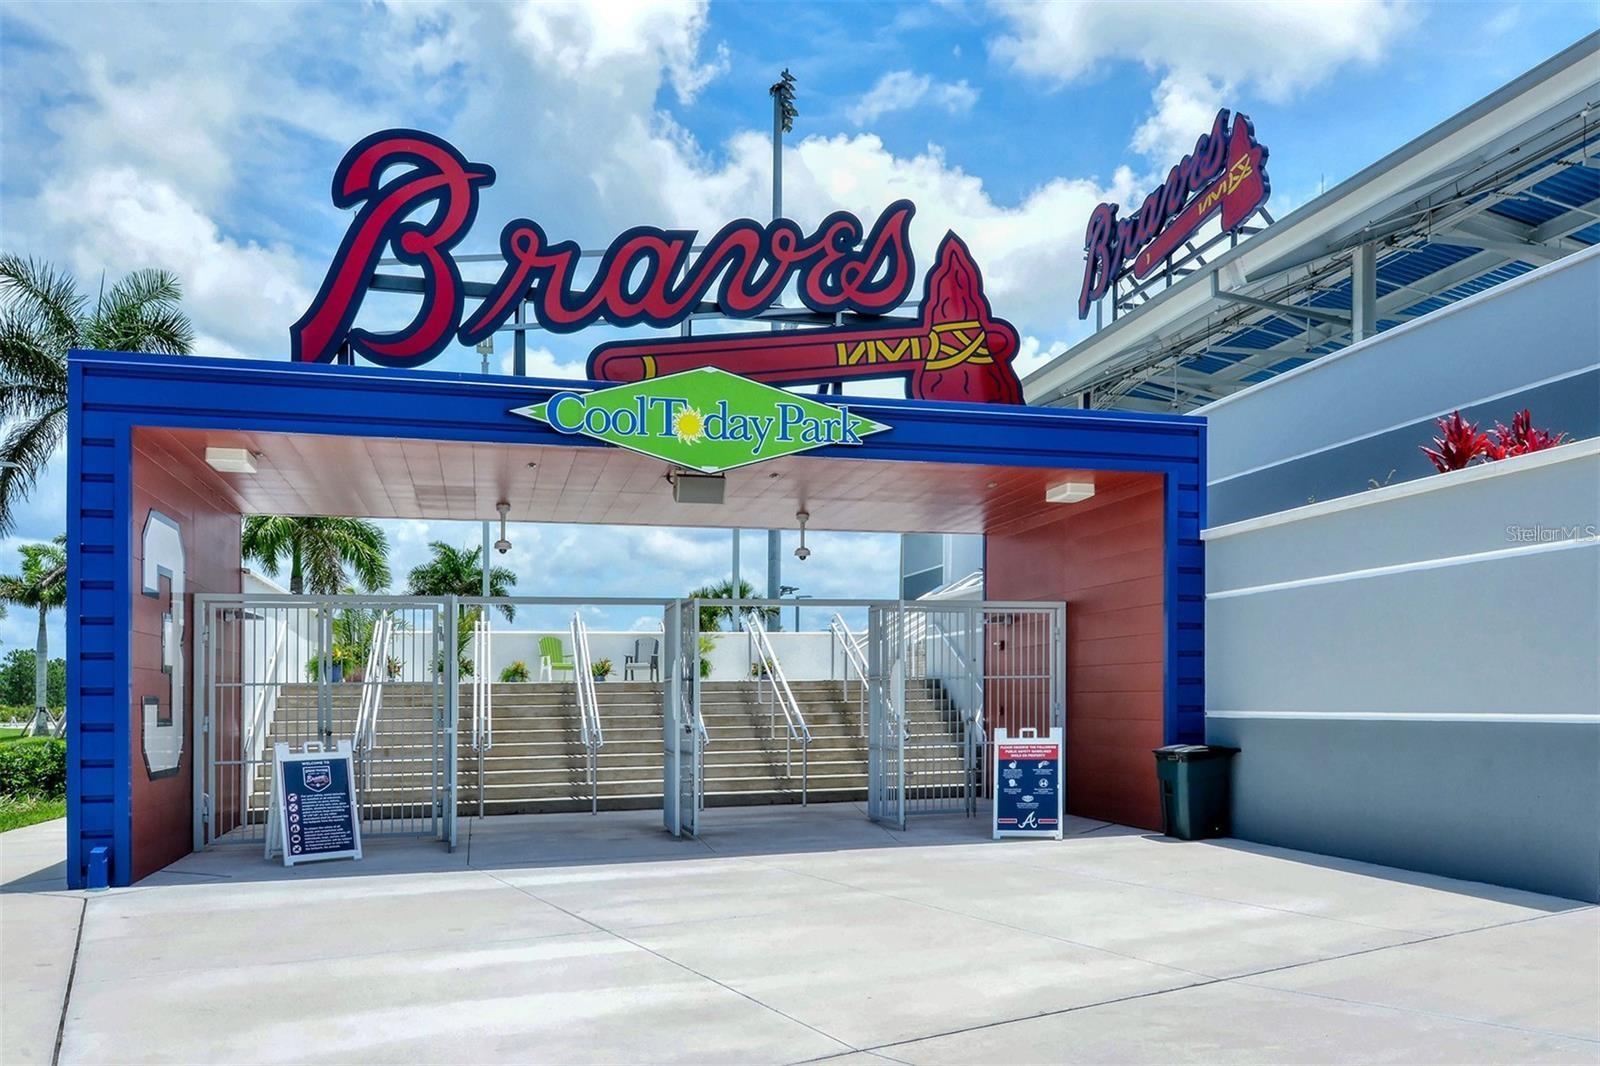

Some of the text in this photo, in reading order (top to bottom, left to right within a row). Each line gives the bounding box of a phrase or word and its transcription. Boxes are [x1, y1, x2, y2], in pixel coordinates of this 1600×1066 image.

[290, 128, 916, 367] Braves
[1079, 107, 1230, 320] Braves
[775, 402, 863, 445] Park
